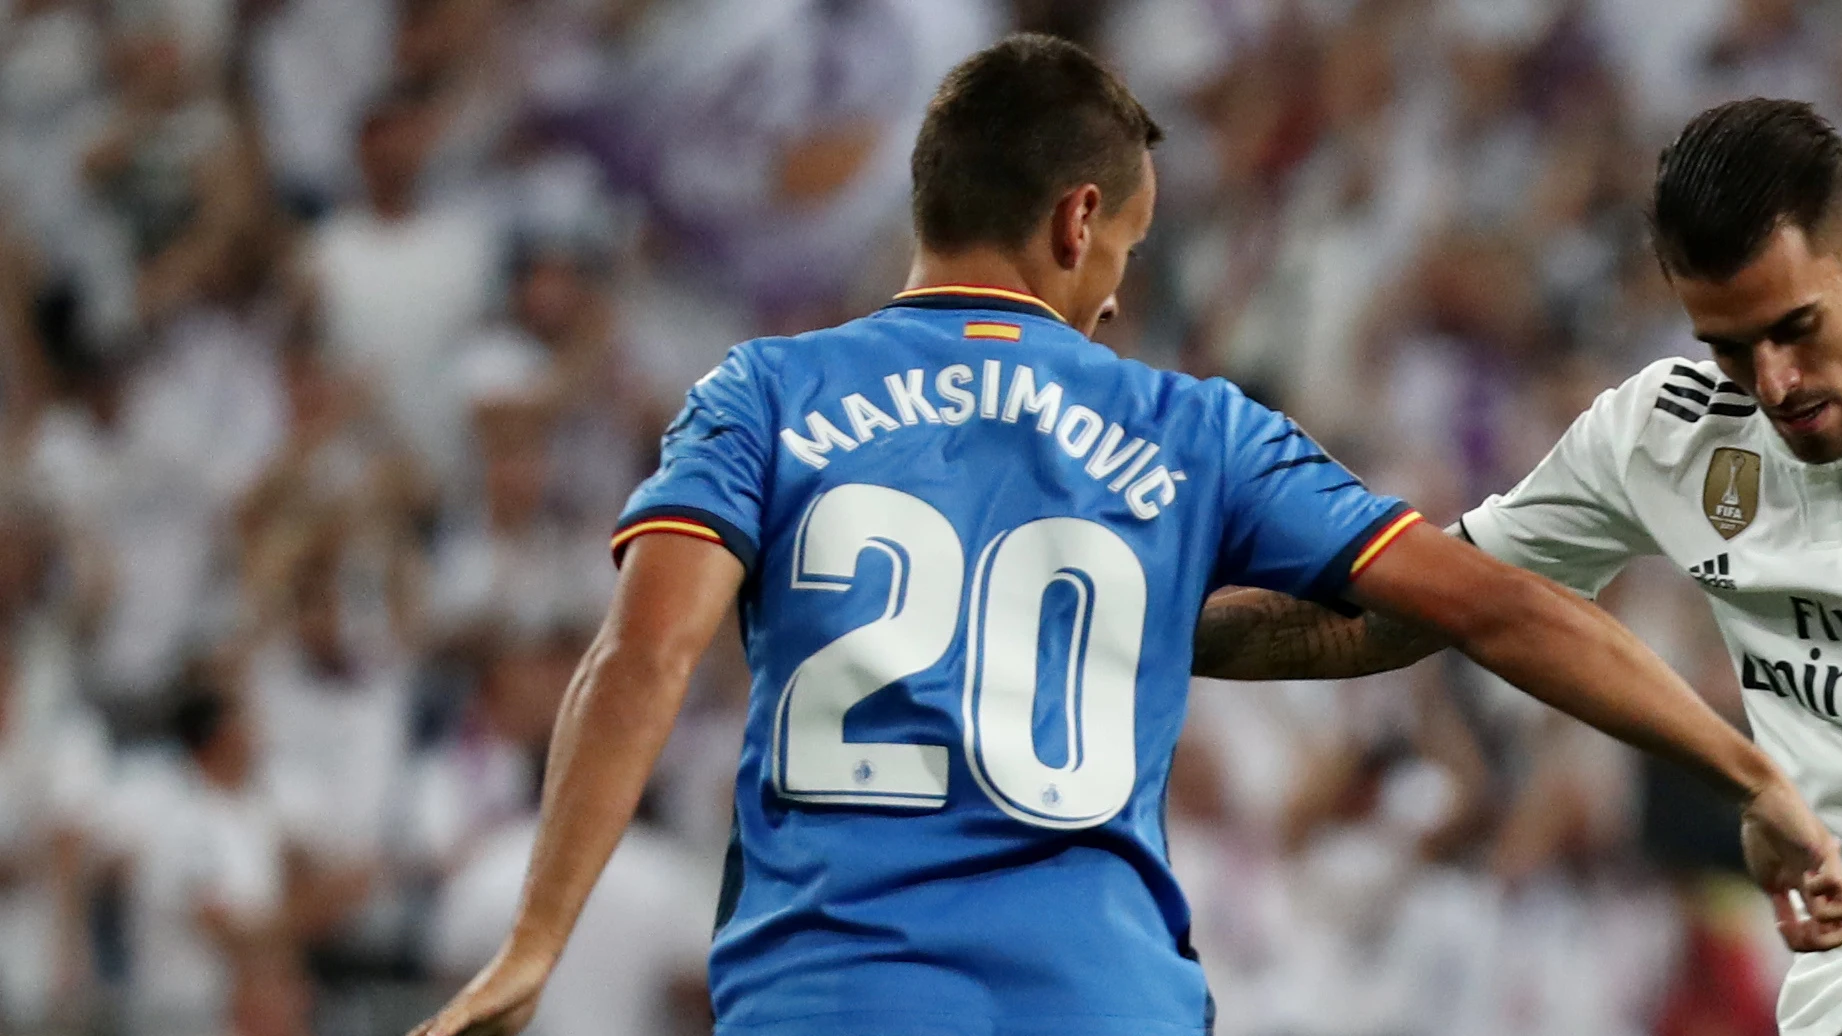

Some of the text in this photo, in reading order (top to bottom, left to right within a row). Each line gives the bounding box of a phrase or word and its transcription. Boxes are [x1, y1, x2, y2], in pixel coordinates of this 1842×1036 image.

[779, 360, 1187, 521] MAKSIMOVIĆ
[1716, 504, 1743, 519] FIFA
[772, 483, 1148, 830] 20
